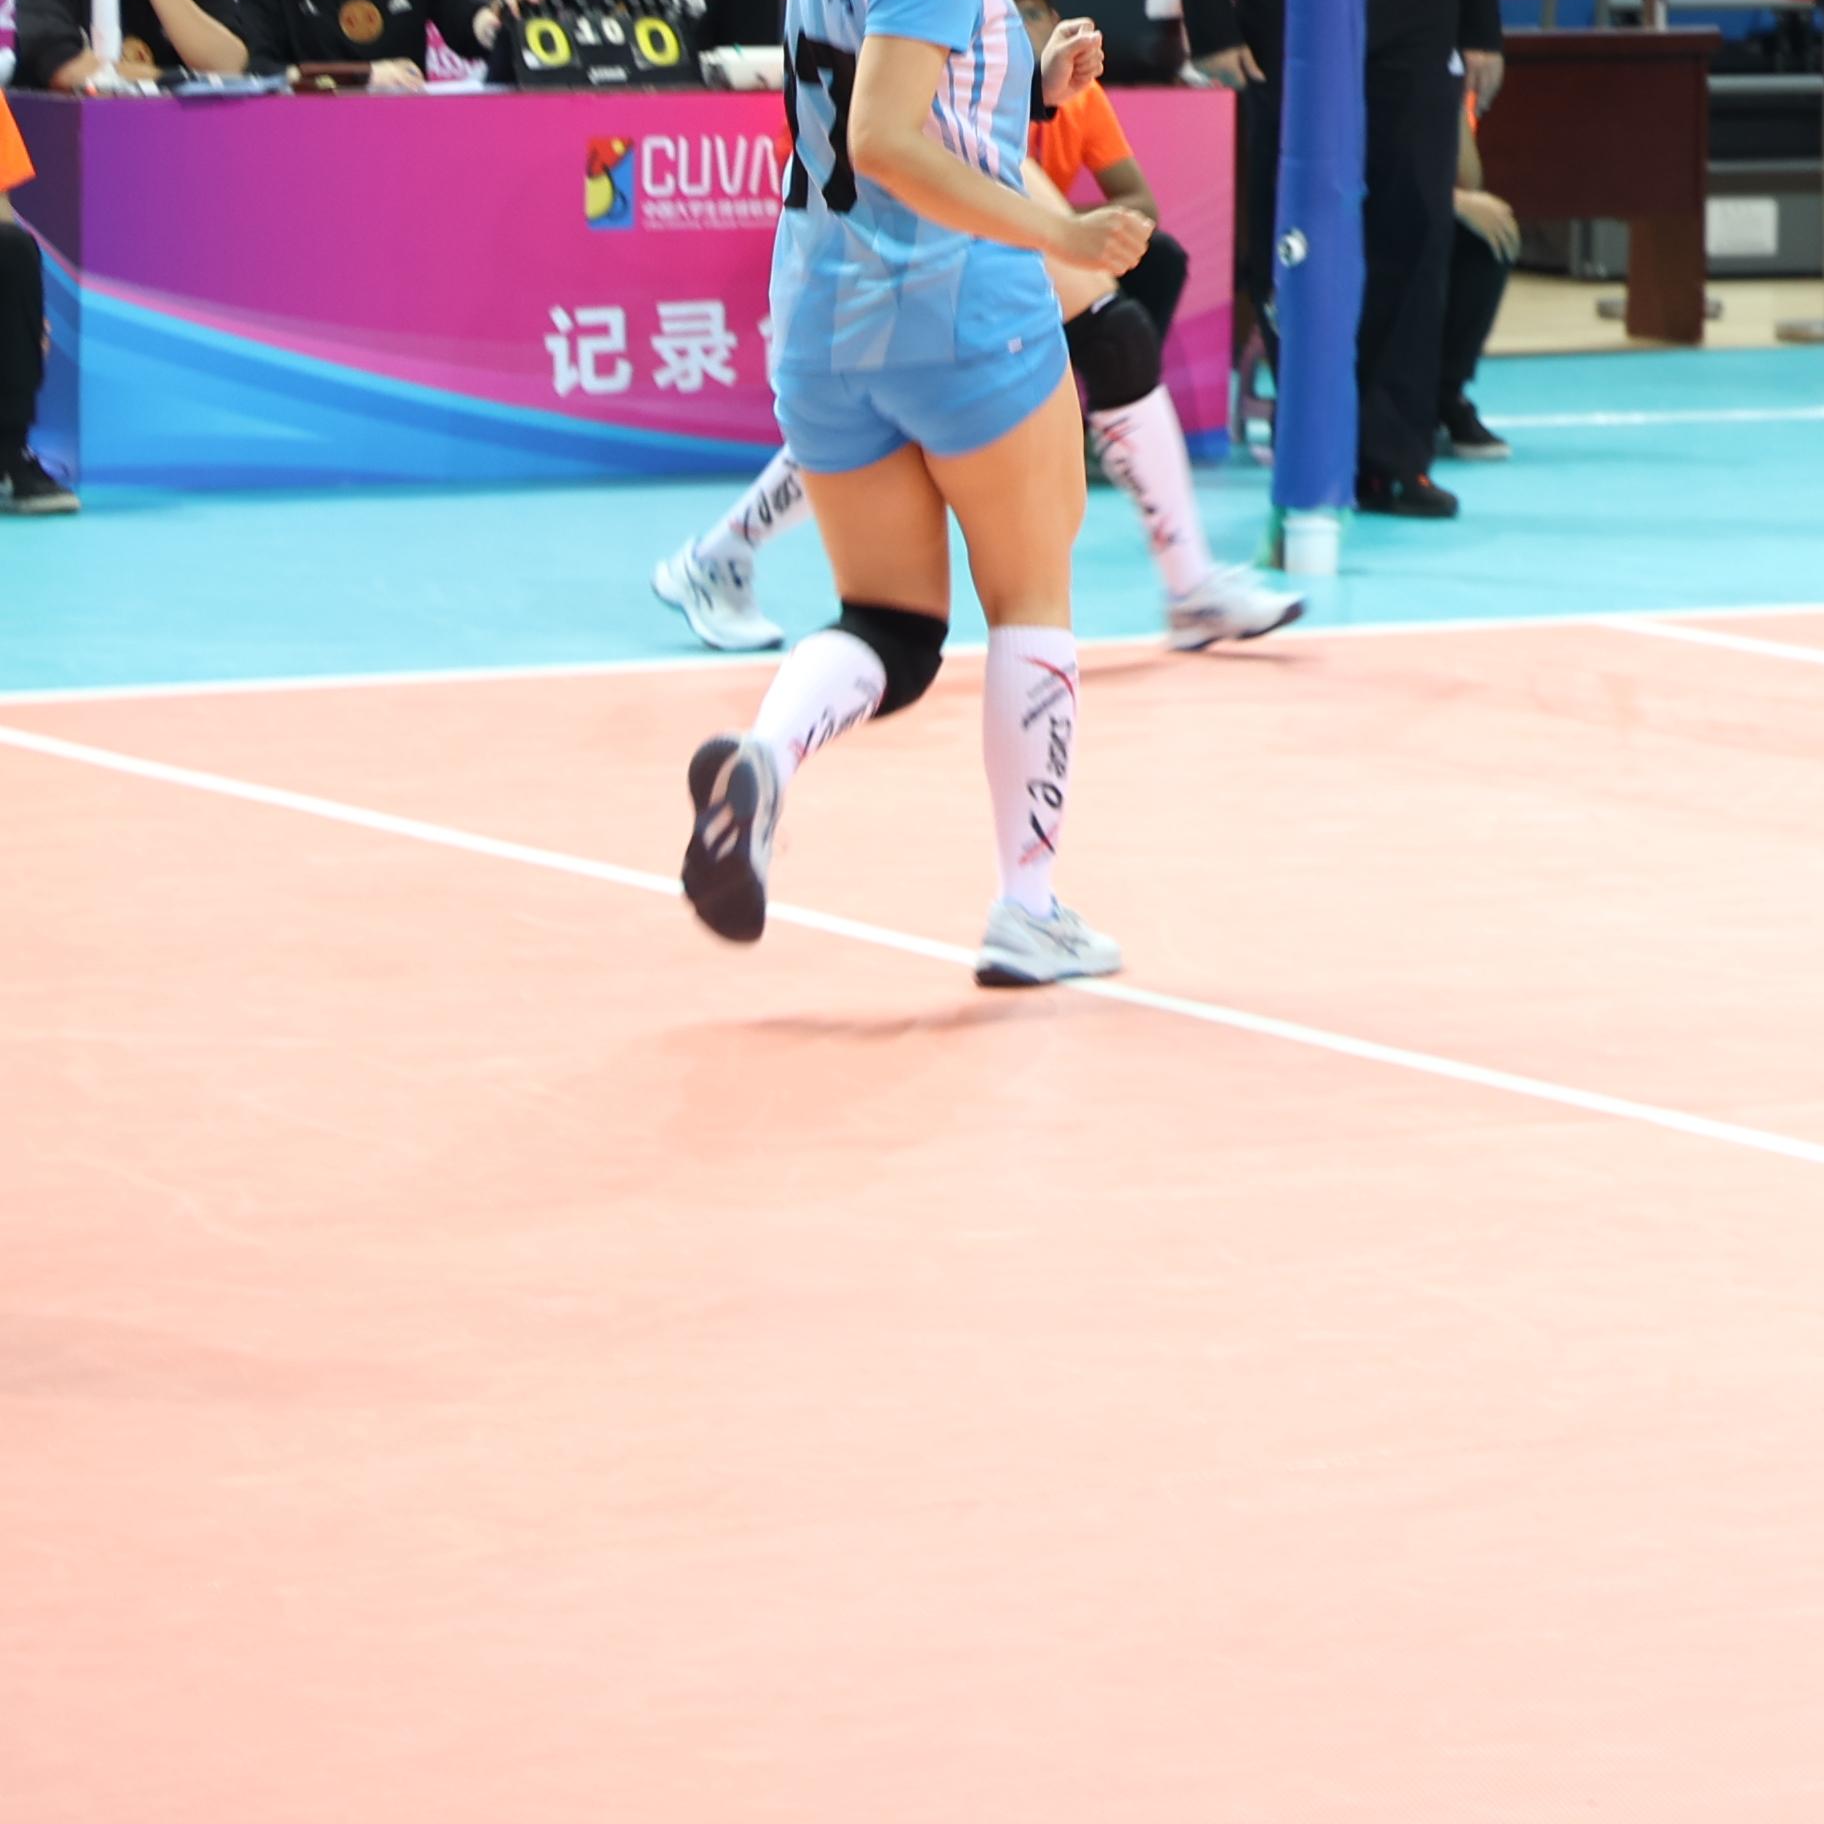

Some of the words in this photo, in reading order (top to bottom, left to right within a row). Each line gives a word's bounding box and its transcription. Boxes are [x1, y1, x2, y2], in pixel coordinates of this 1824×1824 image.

[525, 17, 571, 67] 0
[634, 16, 680, 67] 0
[642, 134, 780, 197] CUVA
[545, 305, 772, 397] 记录
